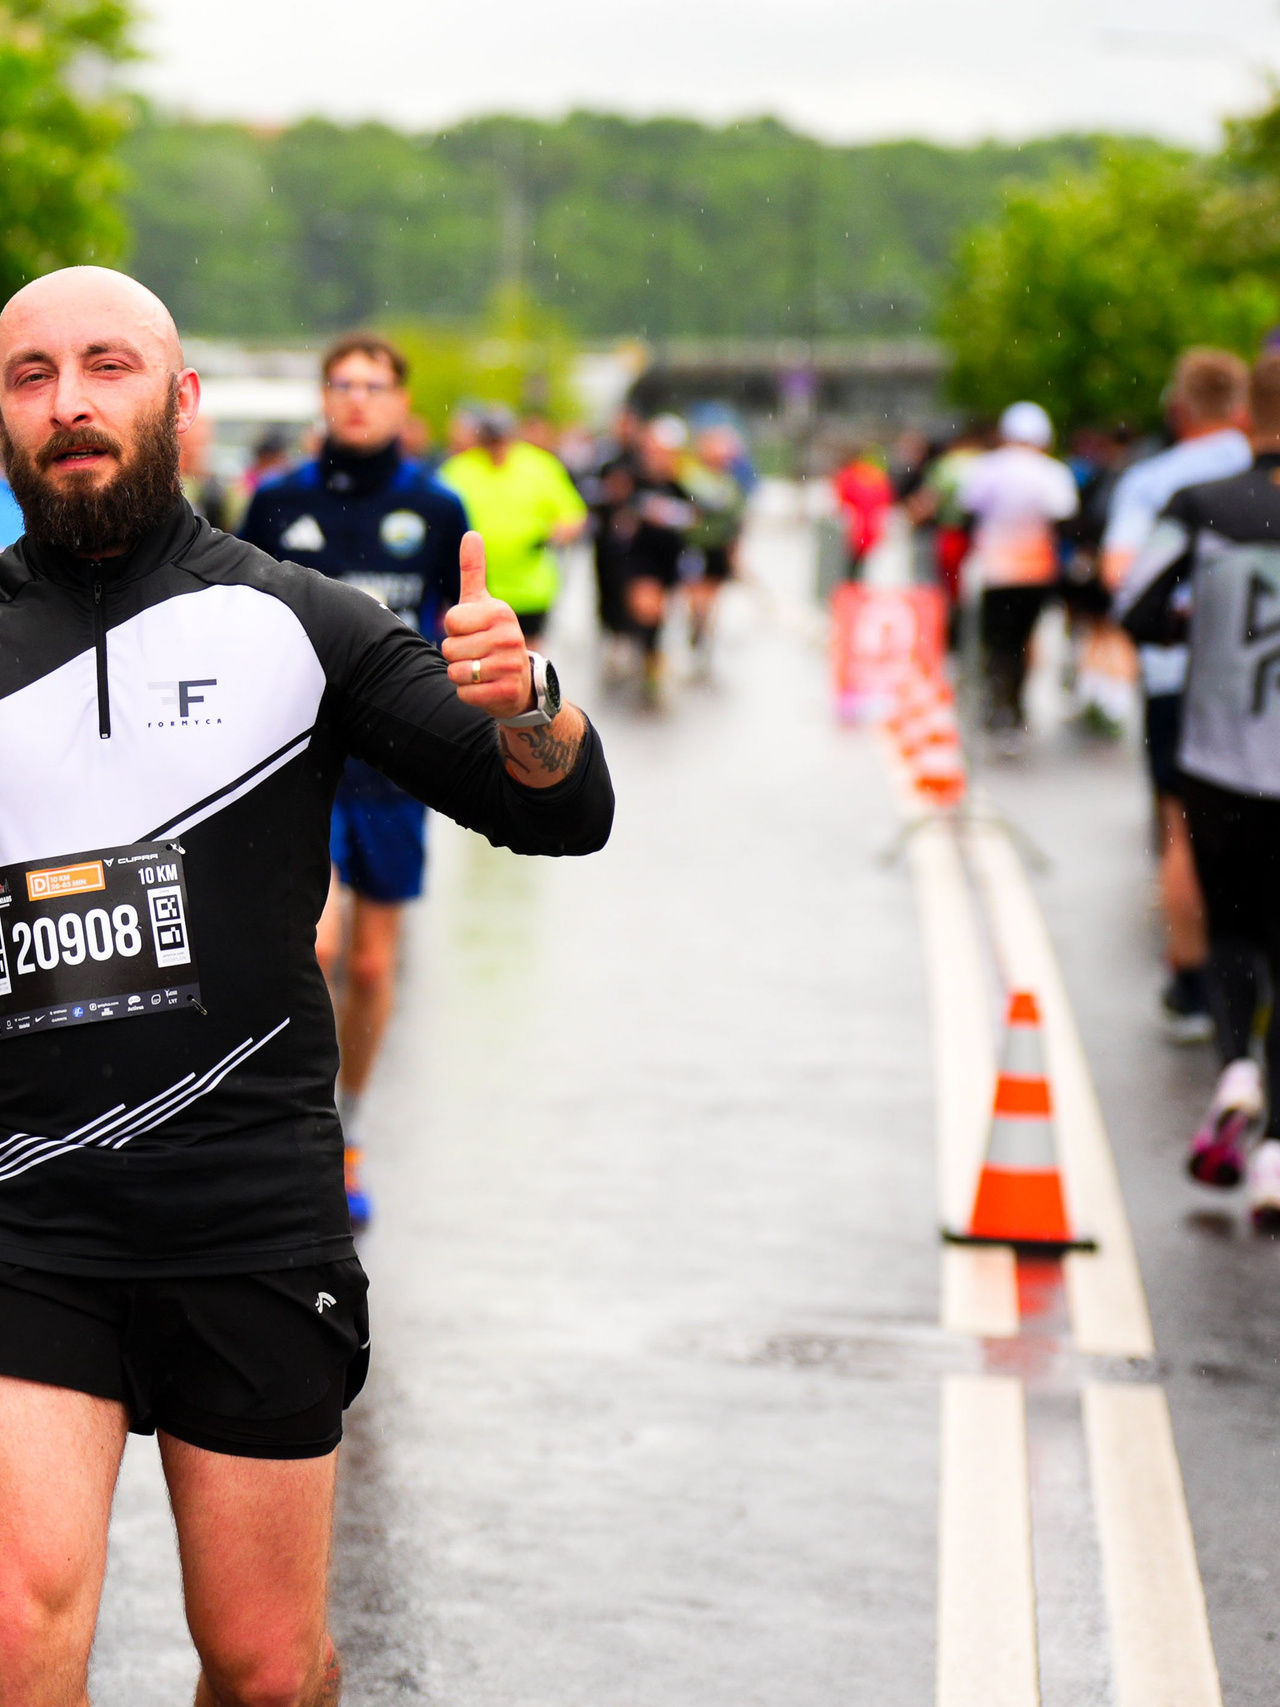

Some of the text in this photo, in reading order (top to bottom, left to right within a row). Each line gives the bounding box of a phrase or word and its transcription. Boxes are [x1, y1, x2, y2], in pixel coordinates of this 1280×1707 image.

[147, 718, 222, 728] FORMYCA
[117, 853, 159, 865] CUPRA
[50, 874, 71, 883] 10 KM
[137, 864, 178, 885] 10 KM
[34, 878, 46, 892] D
[72, 878, 87, 888] MIN
[11, 904, 142, 976] 20908
